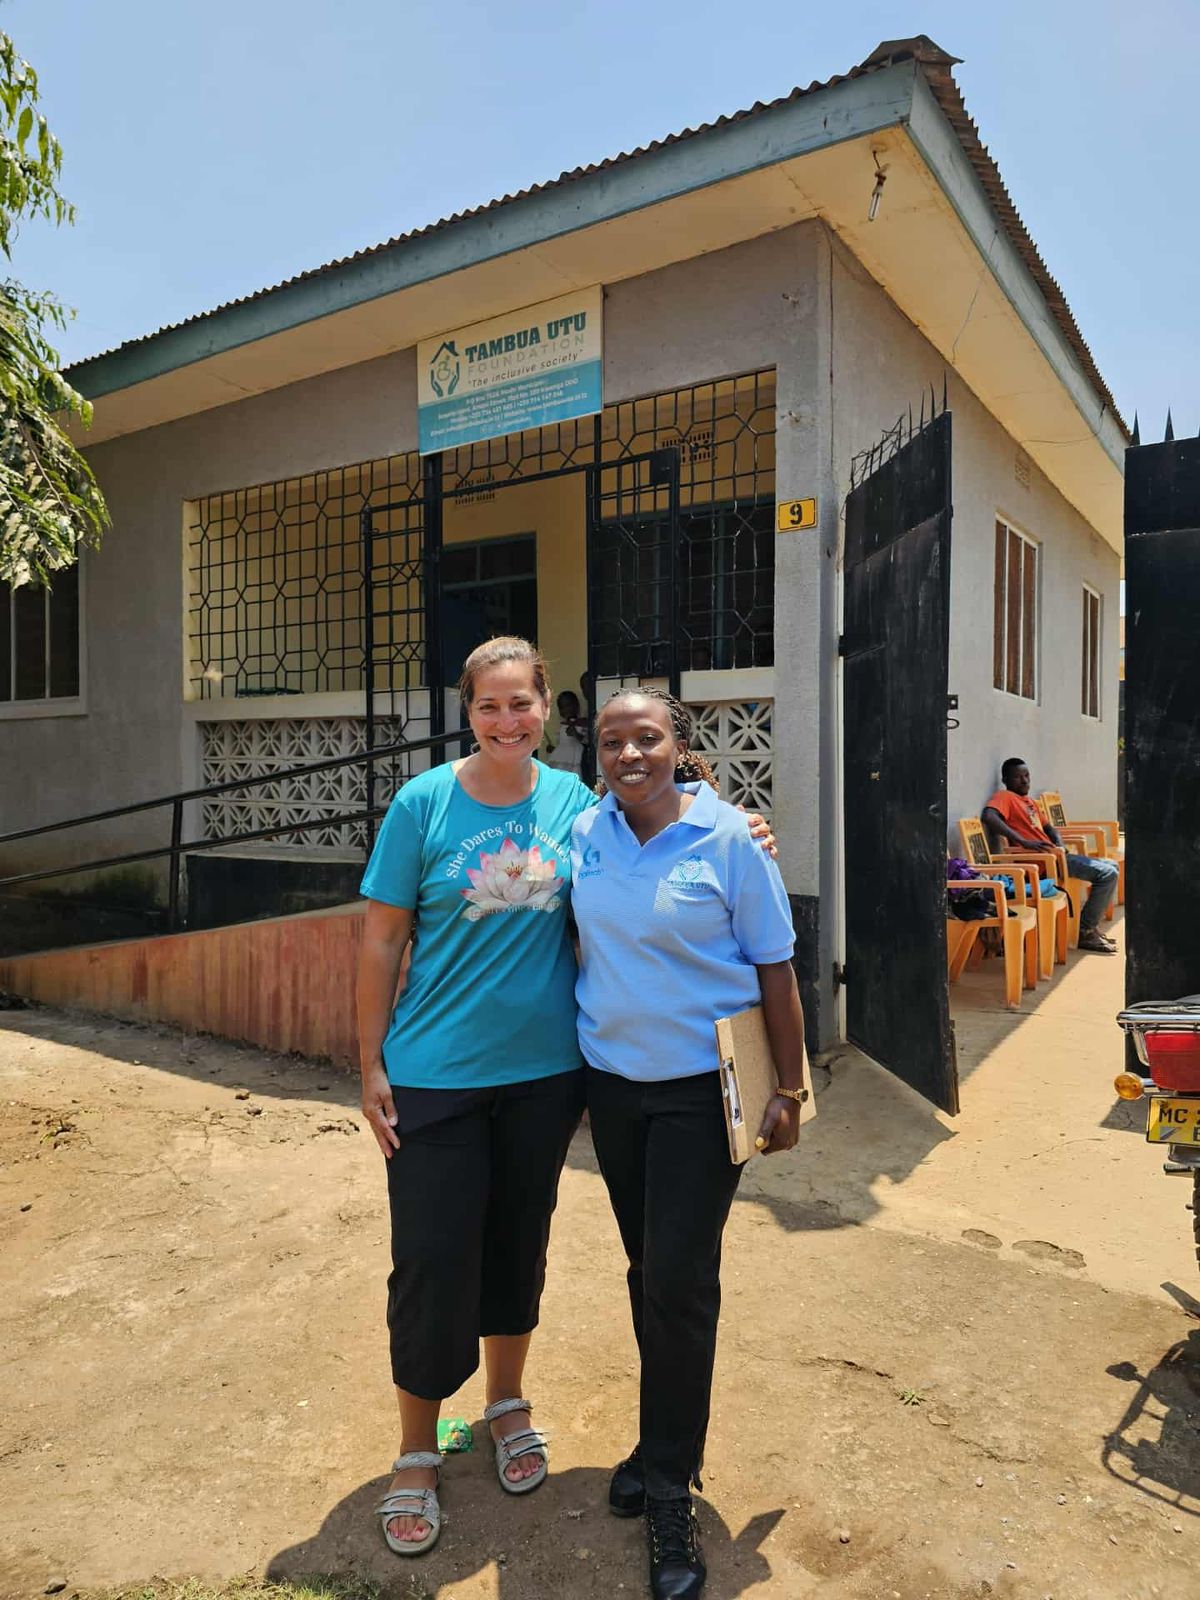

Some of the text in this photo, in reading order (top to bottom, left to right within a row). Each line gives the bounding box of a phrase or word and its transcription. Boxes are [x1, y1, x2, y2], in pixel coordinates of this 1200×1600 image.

[465, 312, 587, 363] TAMBUA UTU
[468, 333, 585, 376] FOUNDATION
[492, 363, 536, 382] inclusive
[790, 503, 803, 525] 9
[446, 852, 467, 879] She
[461, 826, 504, 852] Dares
[505, 820, 524, 834] To
[1159, 1107, 1188, 1123] MC
